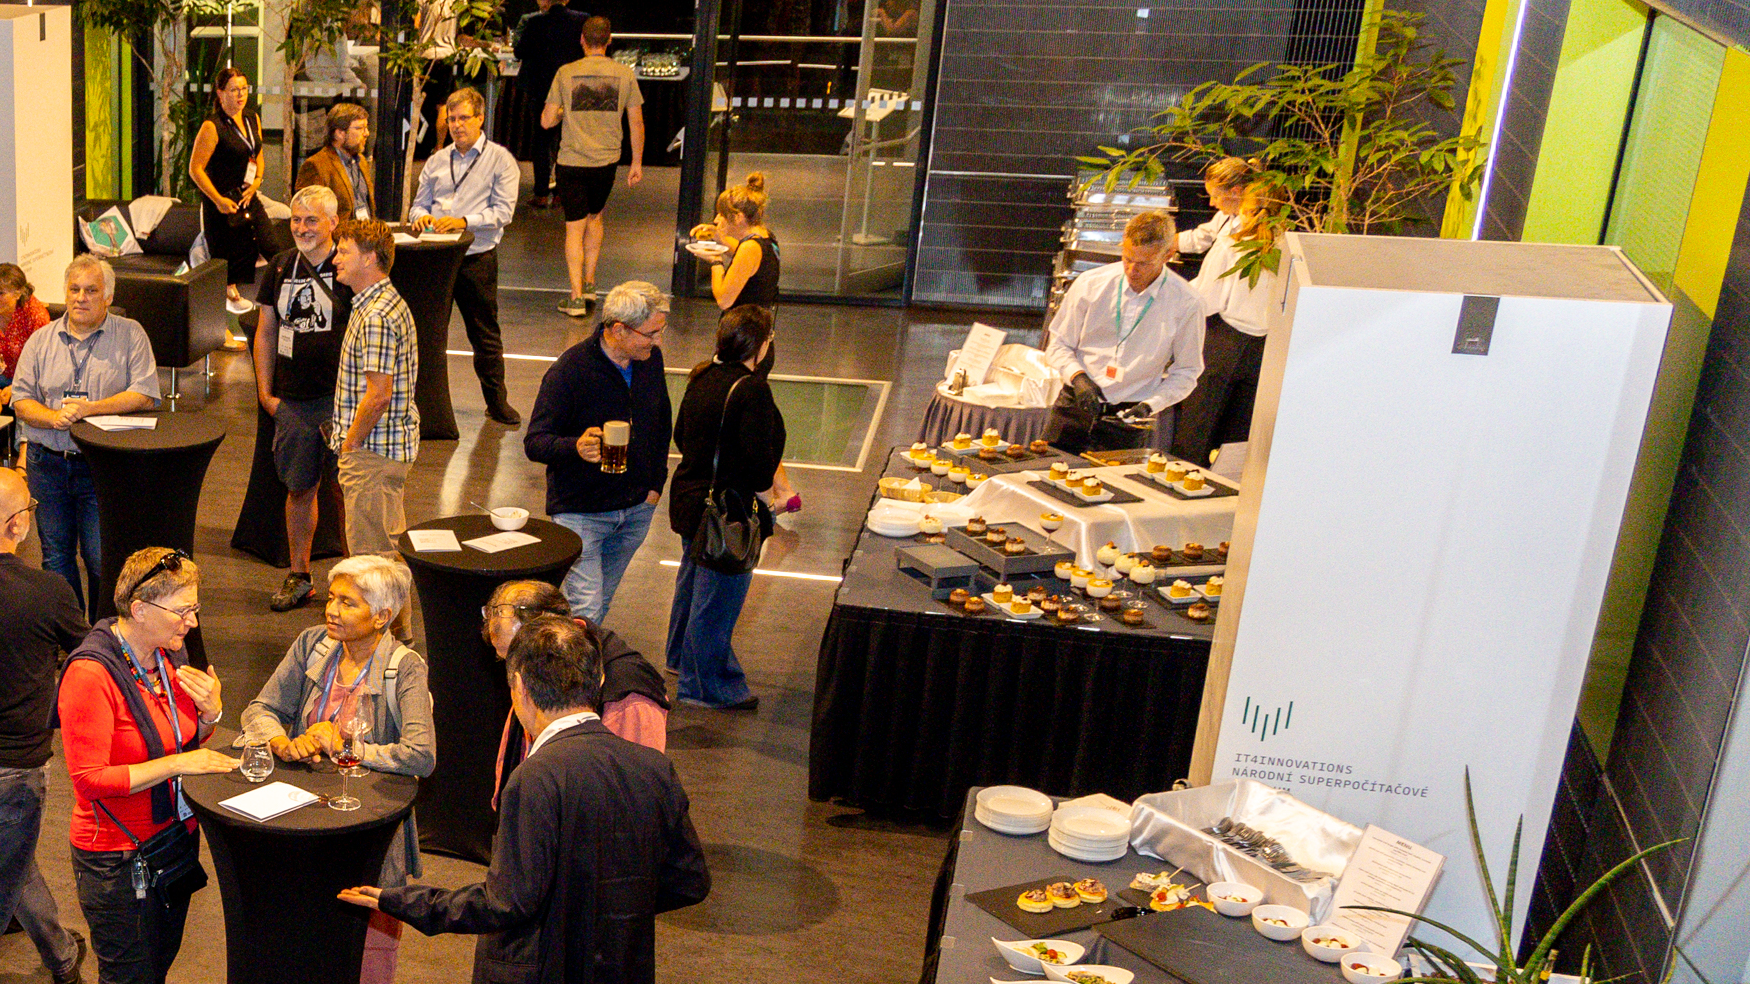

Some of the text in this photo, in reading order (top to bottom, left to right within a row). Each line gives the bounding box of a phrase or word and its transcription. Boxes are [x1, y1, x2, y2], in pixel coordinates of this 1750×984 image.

[1234, 753, 1353, 775] IT4INNOVATIONS
[1231, 767, 1293, 782] NÁRODNÍ
[1299, 774, 1429, 798] SUPERPOČÍTAČOVÉ
